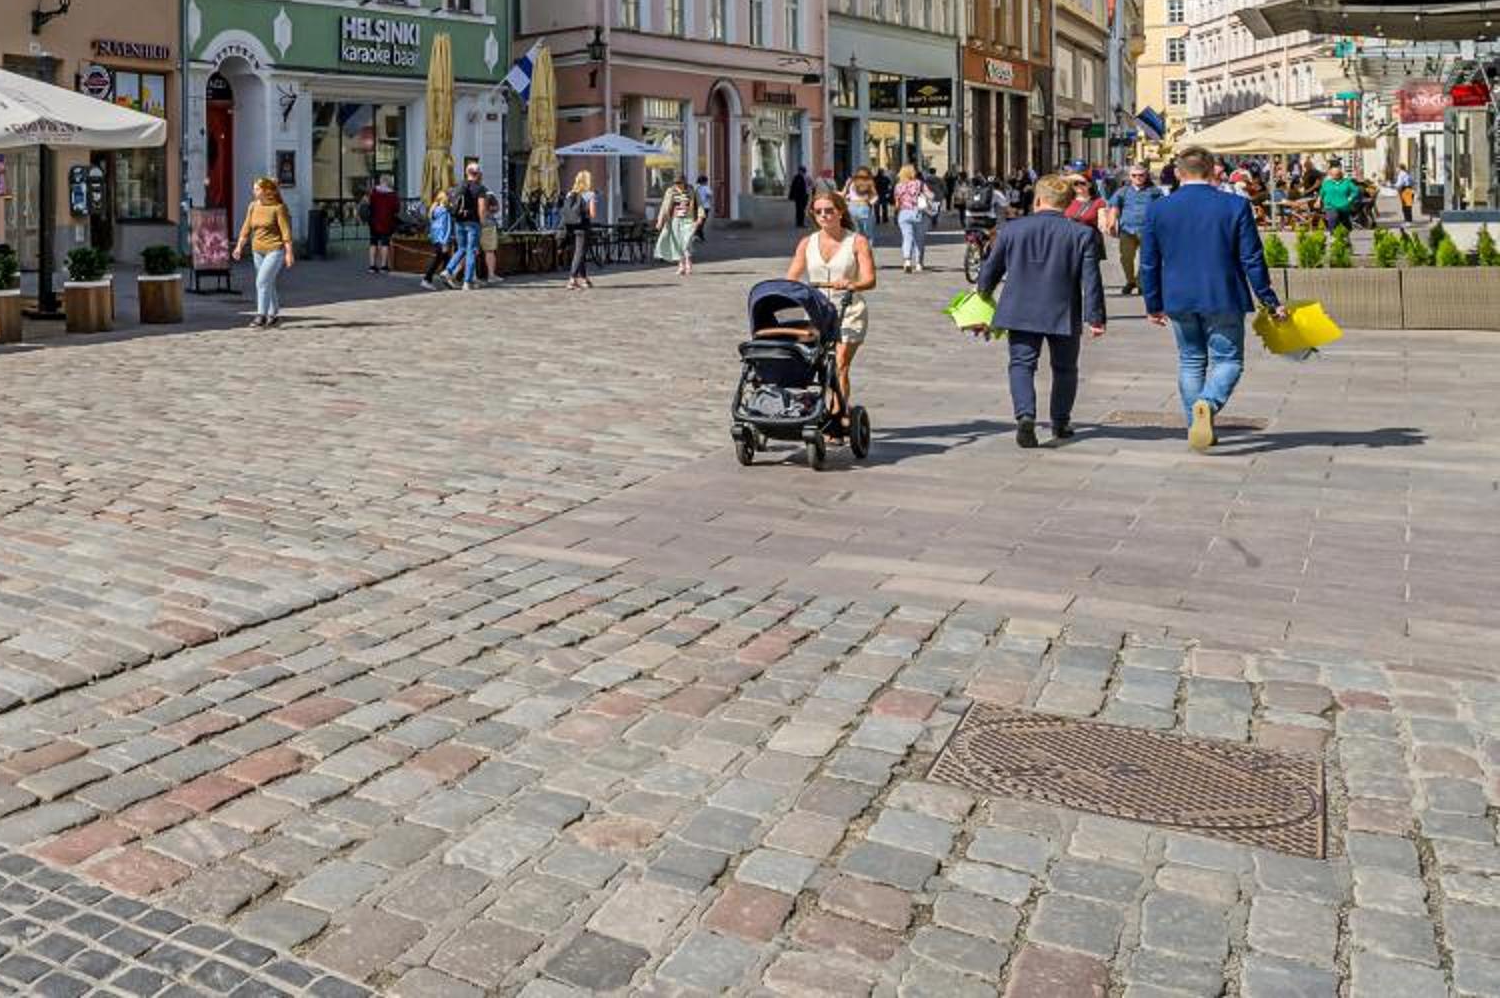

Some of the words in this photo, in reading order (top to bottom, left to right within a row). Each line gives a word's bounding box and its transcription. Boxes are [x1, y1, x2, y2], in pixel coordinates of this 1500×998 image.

[341, 16, 421, 46] HELSINKI
[341, 39, 391, 65] karaoke
[393, 44, 420, 67] baar
